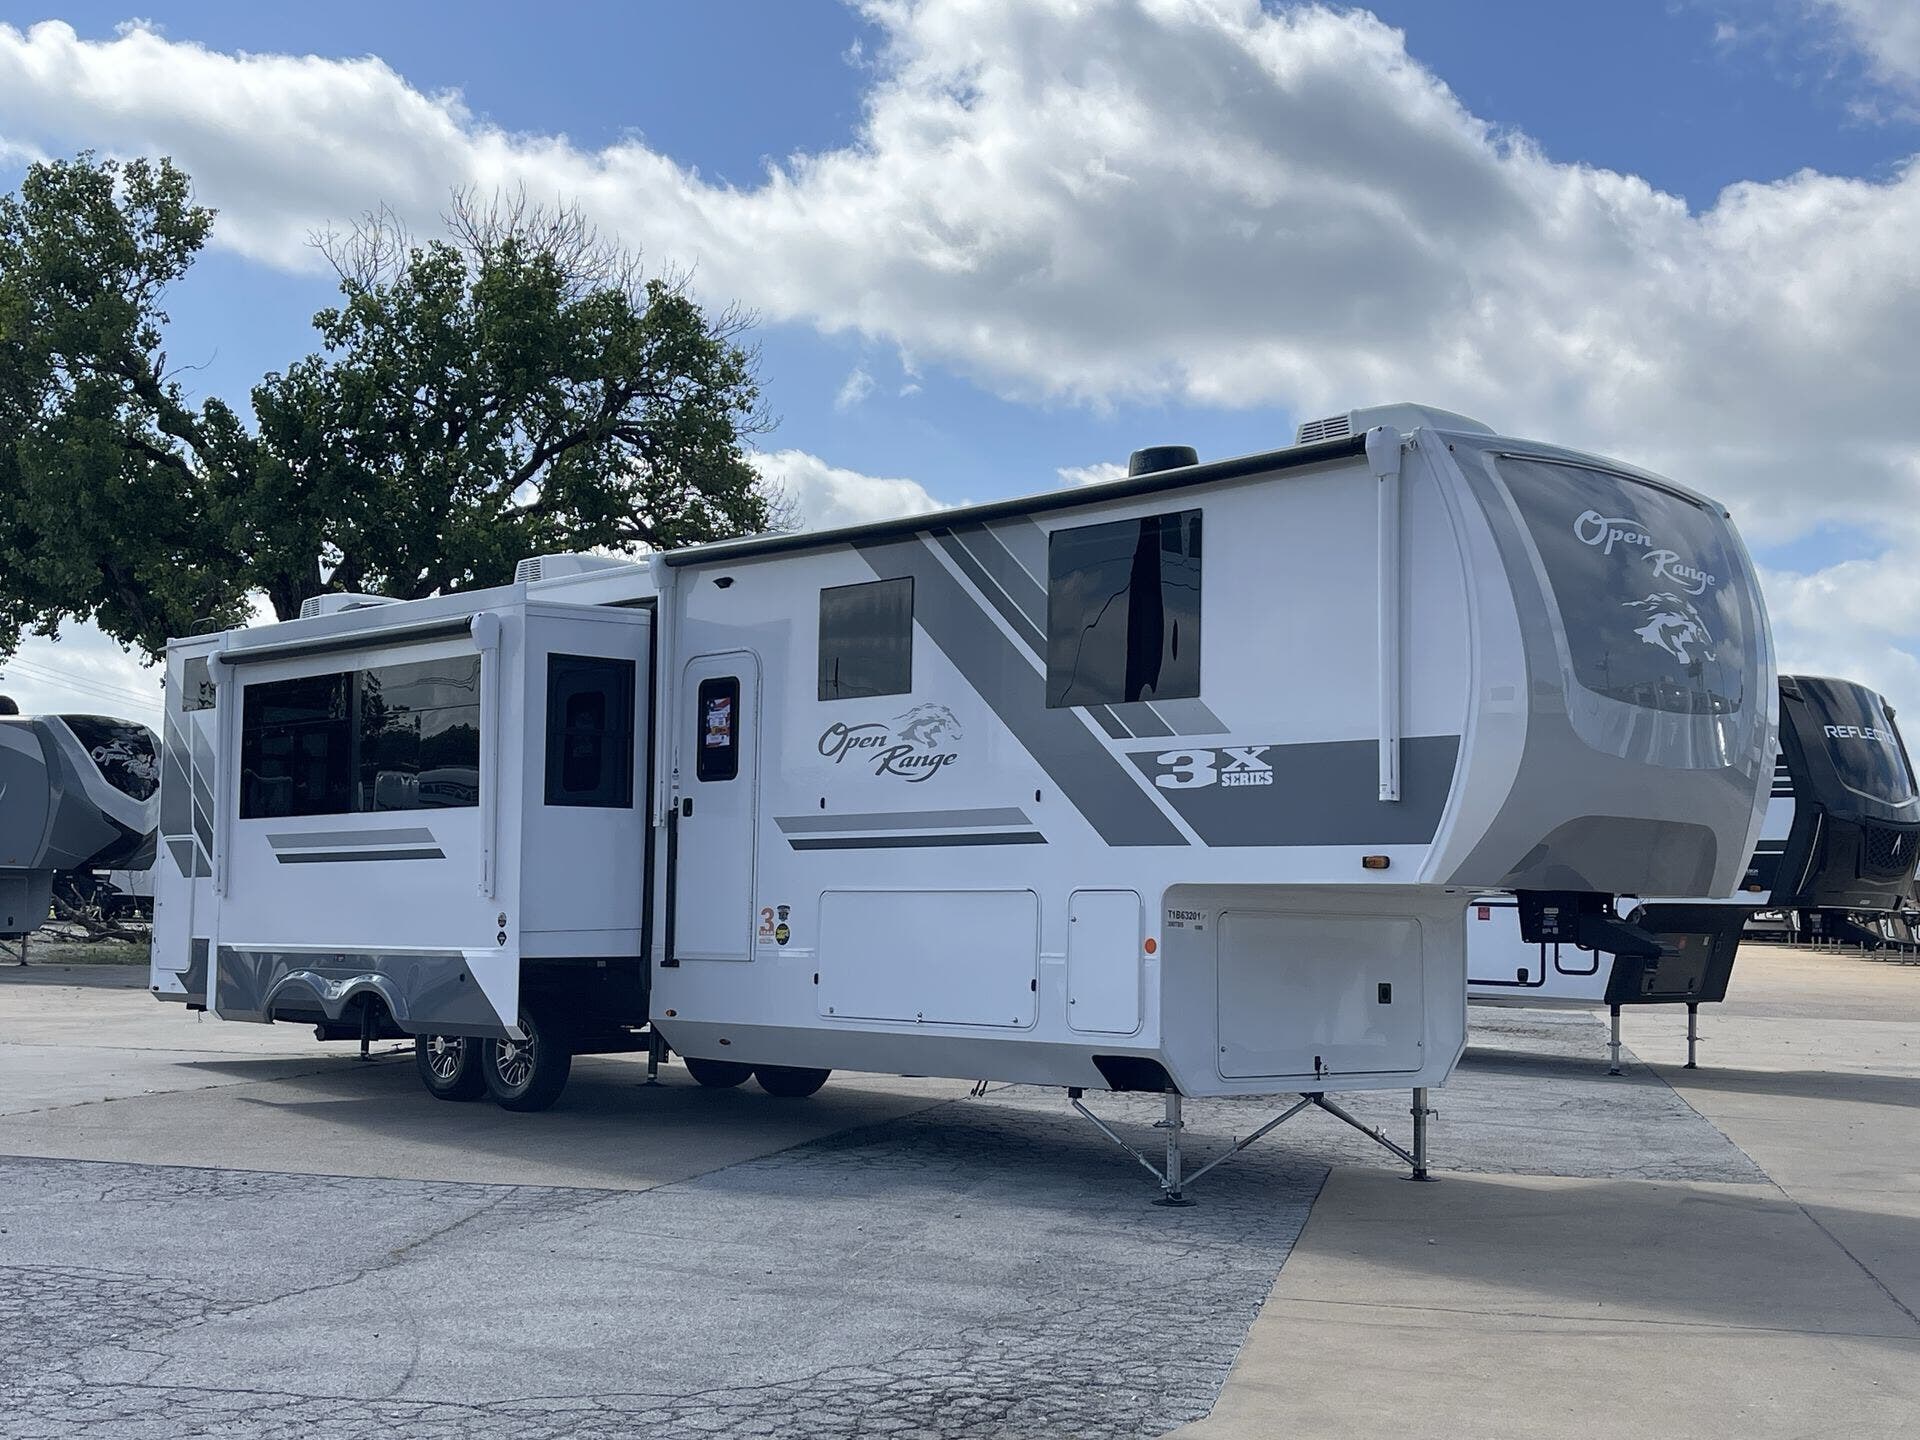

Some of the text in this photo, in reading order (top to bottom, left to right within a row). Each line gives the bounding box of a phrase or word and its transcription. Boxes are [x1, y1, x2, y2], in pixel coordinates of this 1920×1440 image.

[1573, 510, 1652, 555] Open
[1641, 549, 1716, 595] Range
[818, 722, 890, 764] Open
[868, 744, 958, 783] Range
[1221, 771, 1274, 787] SERIES
[760, 907, 775, 932] 3
